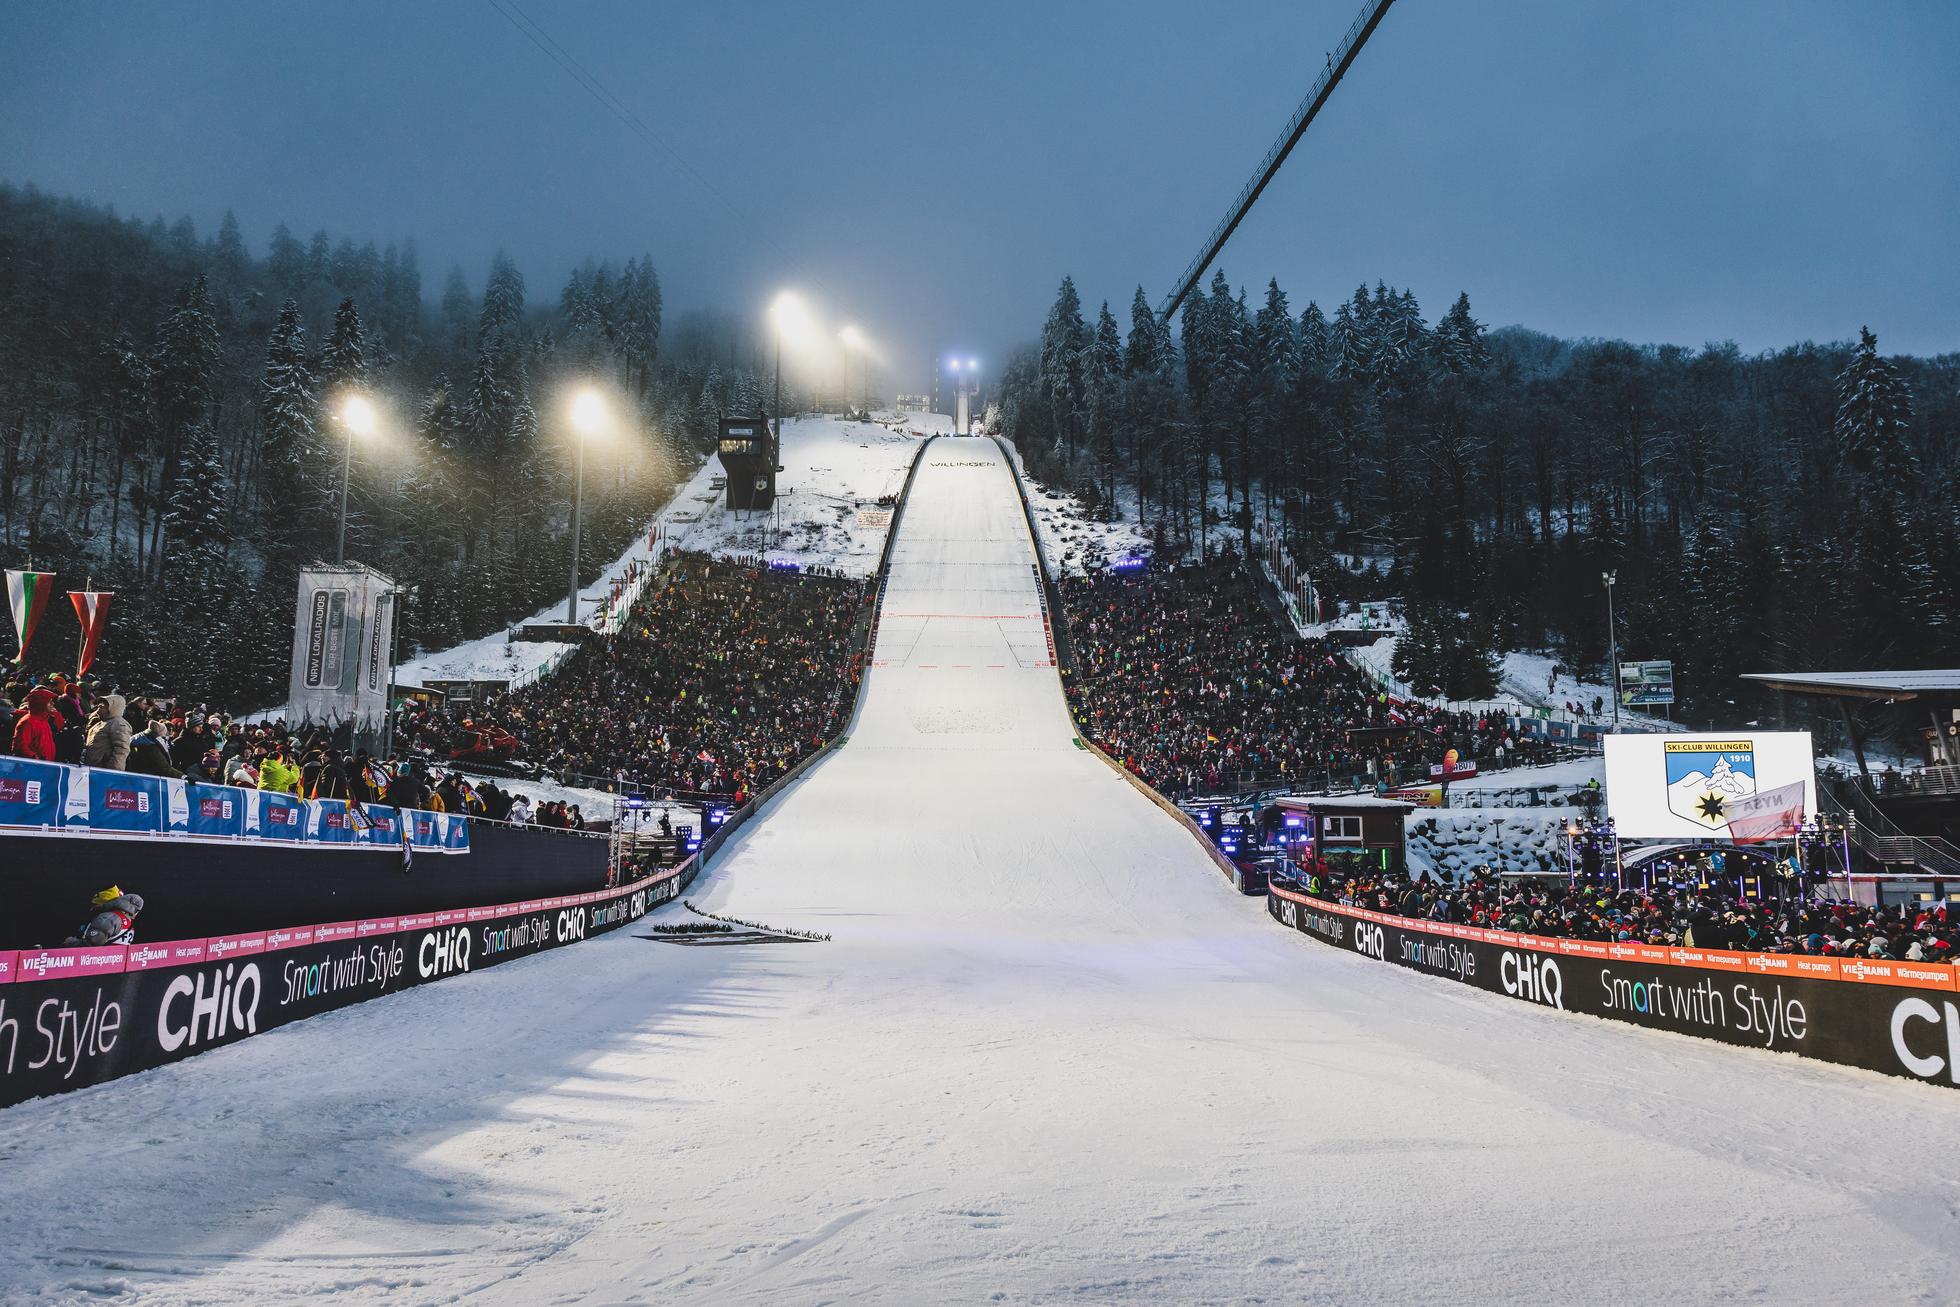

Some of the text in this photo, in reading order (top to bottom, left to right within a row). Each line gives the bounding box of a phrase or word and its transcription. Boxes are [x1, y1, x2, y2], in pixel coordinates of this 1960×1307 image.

[310, 595, 326, 682] NRW LOKALRADIOS
[630, 890, 646, 919] CHiQ
[1281, 900, 1298, 930] CHiQ
[482, 914, 550, 956] Smart with Style
[557, 906, 586, 942] CHiQ
[1330, 916, 1343, 944] Style
[1354, 921, 1385, 962] CHiQ
[23, 952, 74, 976] VIESSMANN
[80, 954, 124, 966] Wärmepumpen
[130, 946, 202, 967] VIESSMANN Heat pumps
[209, 939, 238, 957] VIESSMANN
[418, 926, 471, 978] CHiQ
[1400, 934, 1475, 981] Smart with Style
[1608, 945, 1636, 958] VIESSMANN
[1670, 950, 1703, 964] VIESSMANN
[1748, 954, 1832, 973] VIESSMANN Heat pumps
[280, 940, 404, 1005] Smart with Style
[1500, 950, 1564, 1011] CHiQ
[1842, 962, 1949, 982] VIESSMANN Wärmepumpen
[157, 962, 261, 1052] CHiQ
[1601, 968, 1807, 1047] Smart with Style
[28, 988, 122, 1080] Style
